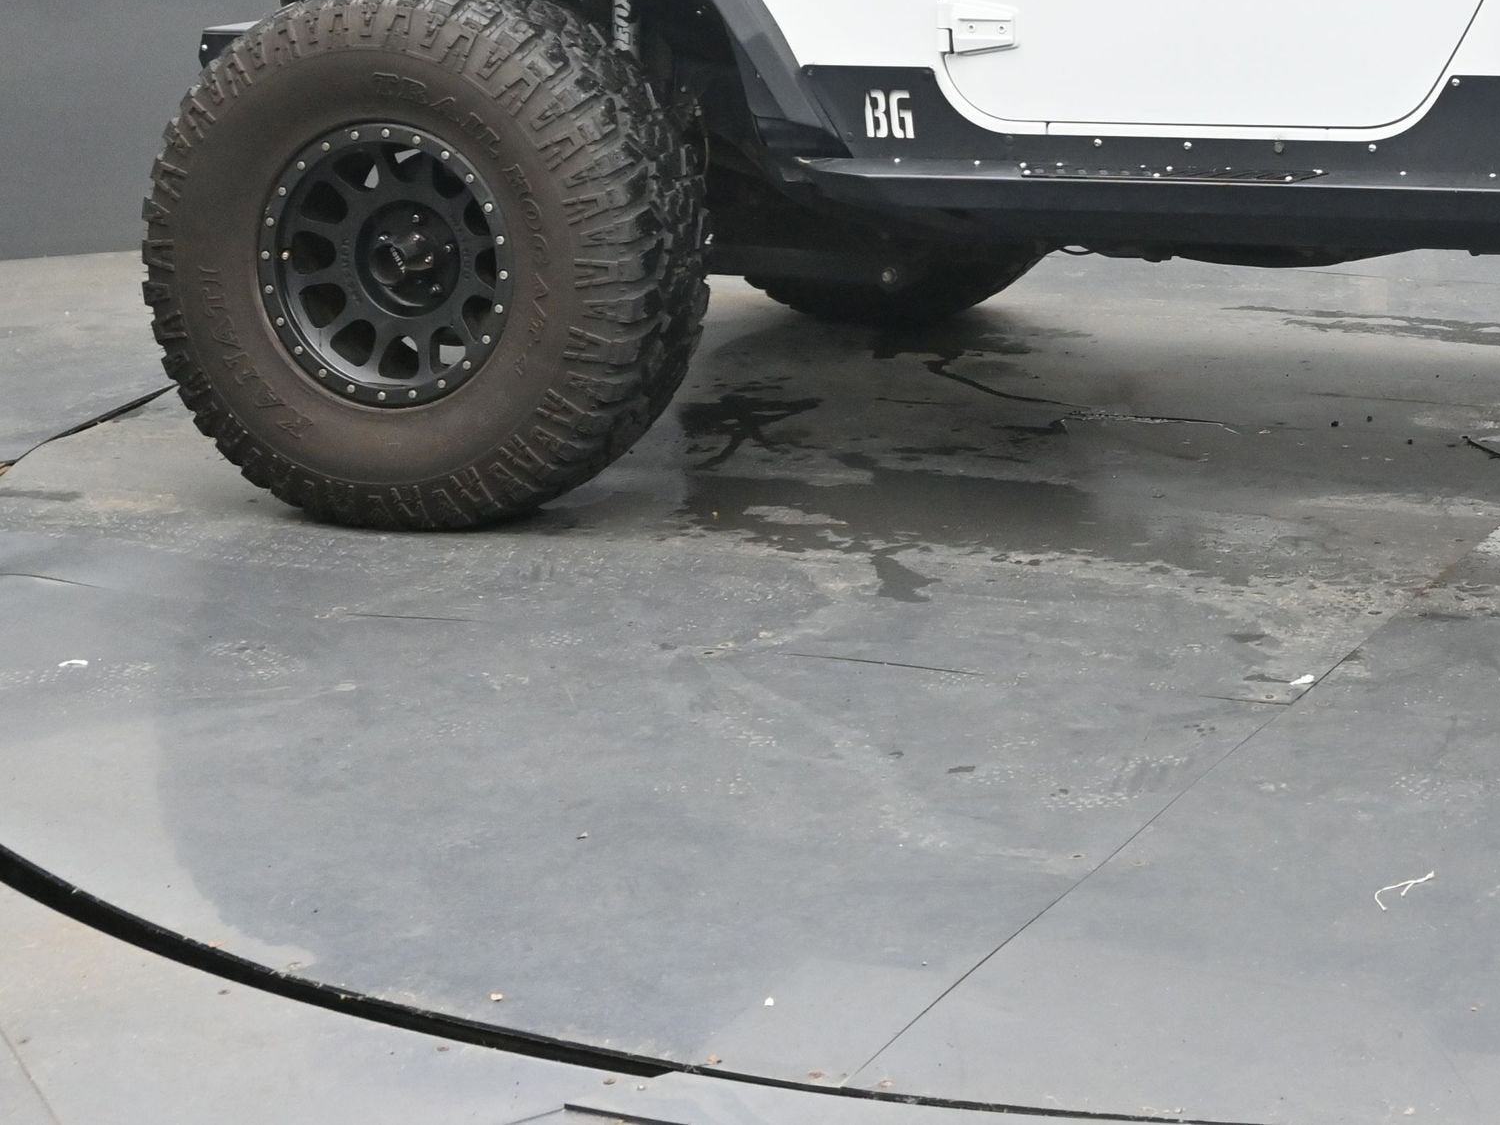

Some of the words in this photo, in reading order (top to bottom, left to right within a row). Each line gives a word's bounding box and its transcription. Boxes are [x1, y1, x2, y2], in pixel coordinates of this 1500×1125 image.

[373, 71, 500, 160] TRAIL
[864, 88, 916, 139] BG
[199, 264, 314, 439] KANATI
